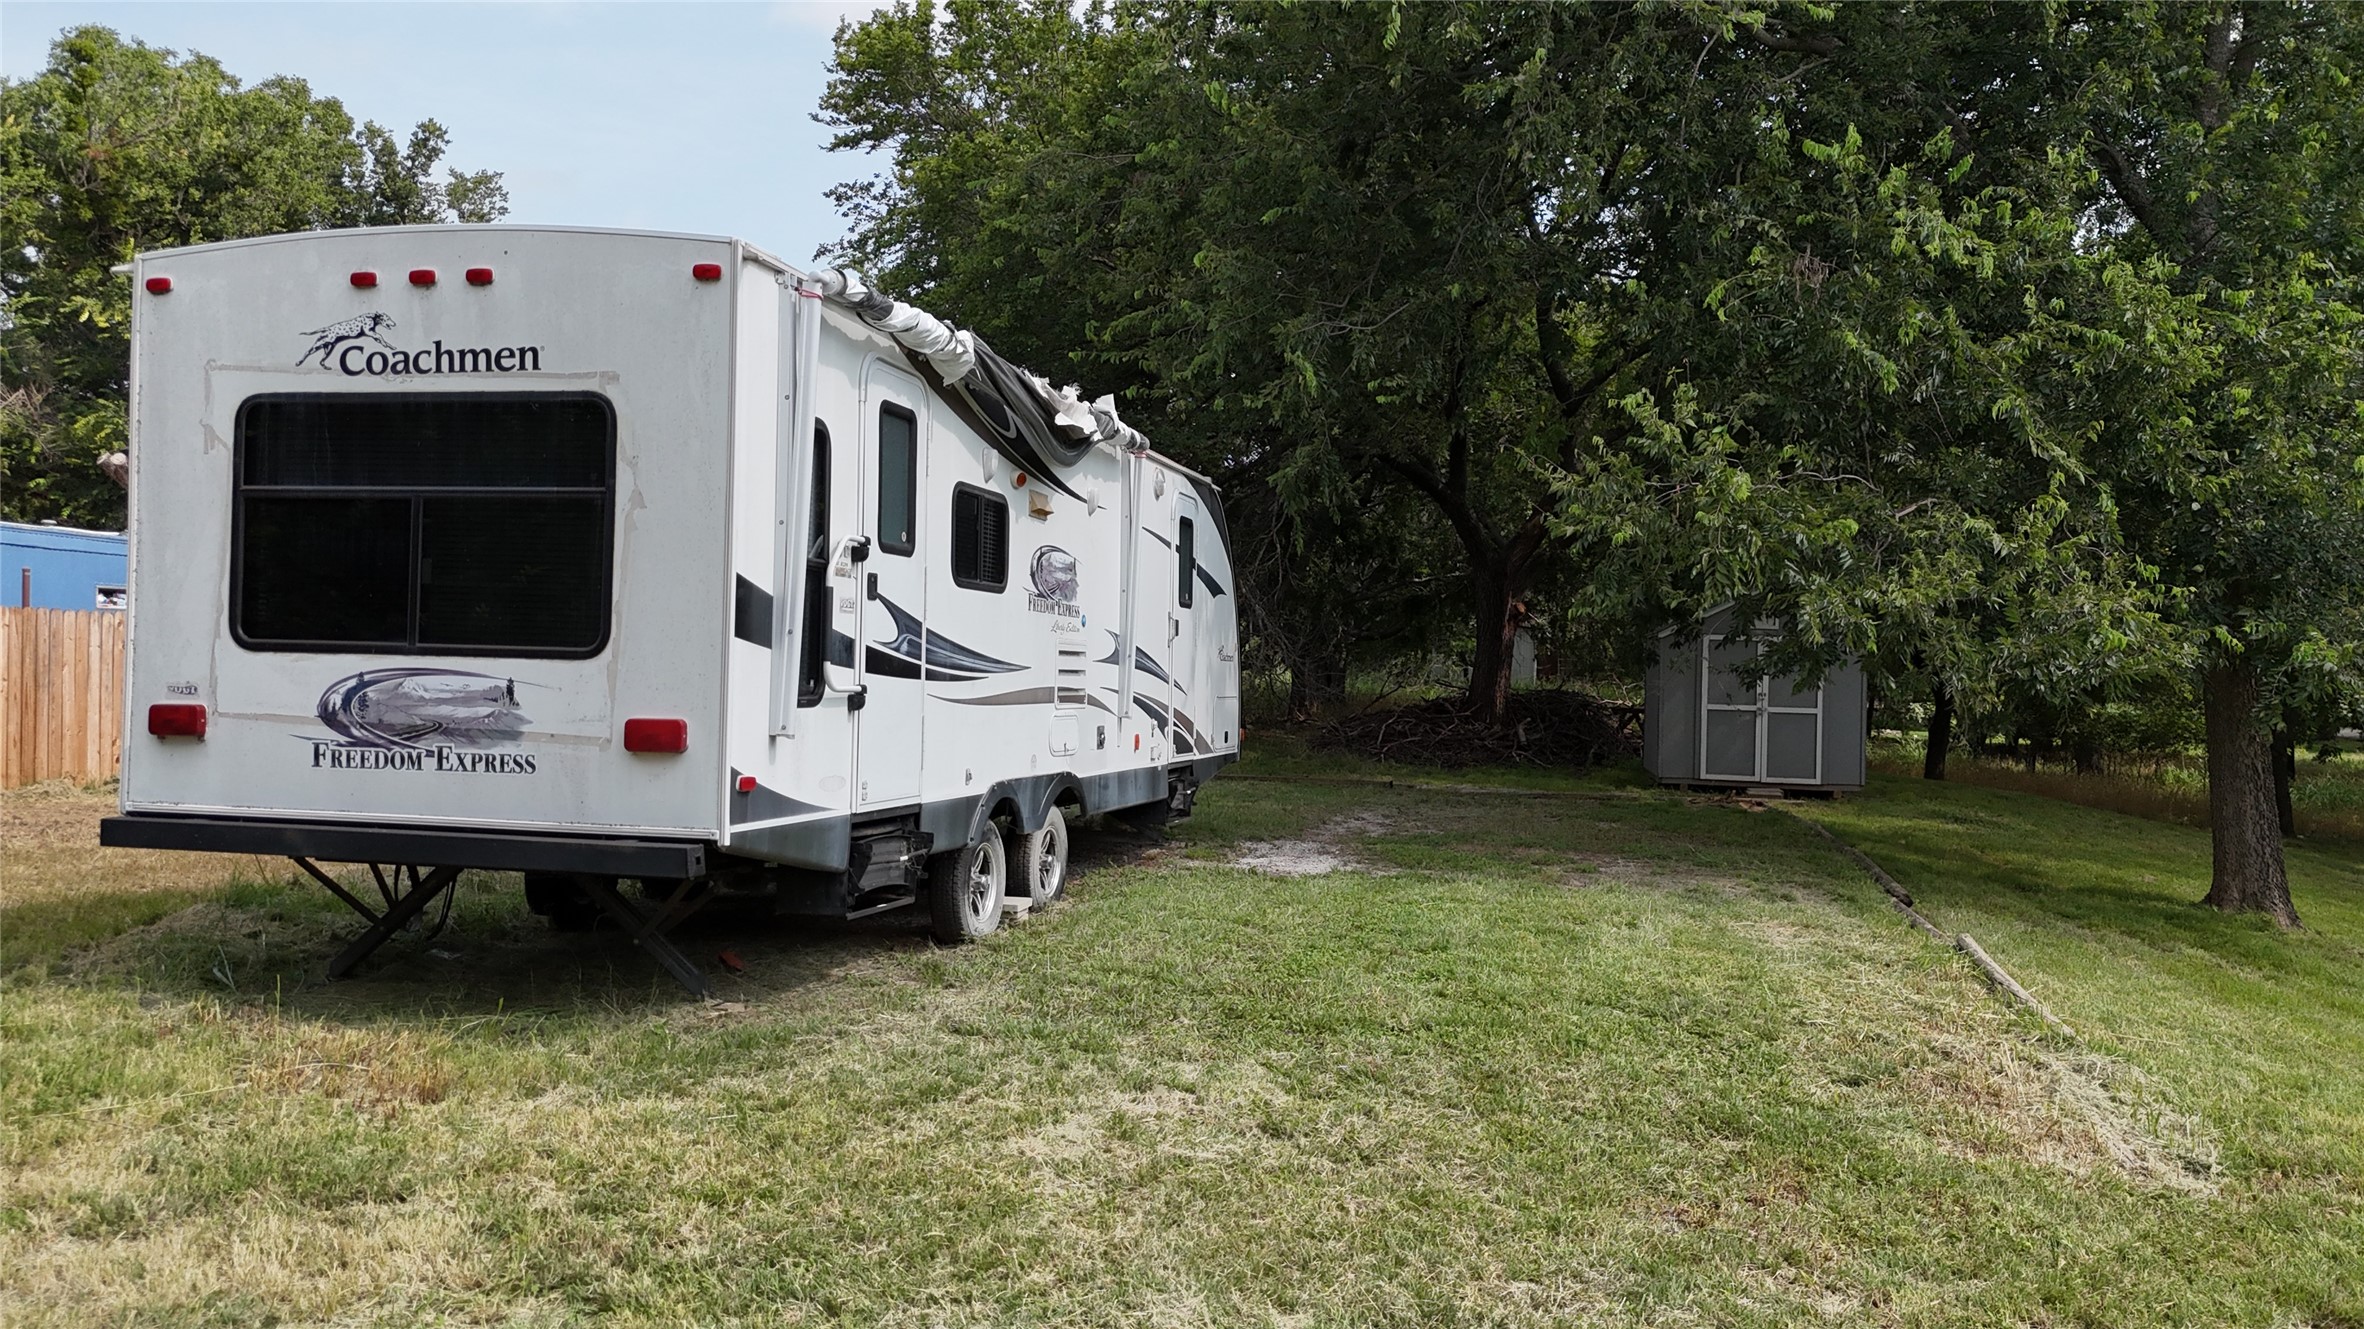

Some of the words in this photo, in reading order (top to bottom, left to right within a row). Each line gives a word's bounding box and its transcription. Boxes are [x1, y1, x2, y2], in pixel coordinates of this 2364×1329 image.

[339, 340, 542, 377] Coachmen
[1027, 592, 1056, 615] FREEDOM
[1057, 598, 1081, 619] EXPRESS
[311, 741, 425, 771] FREEDOM
[434, 745, 537, 775] EXPRESS
